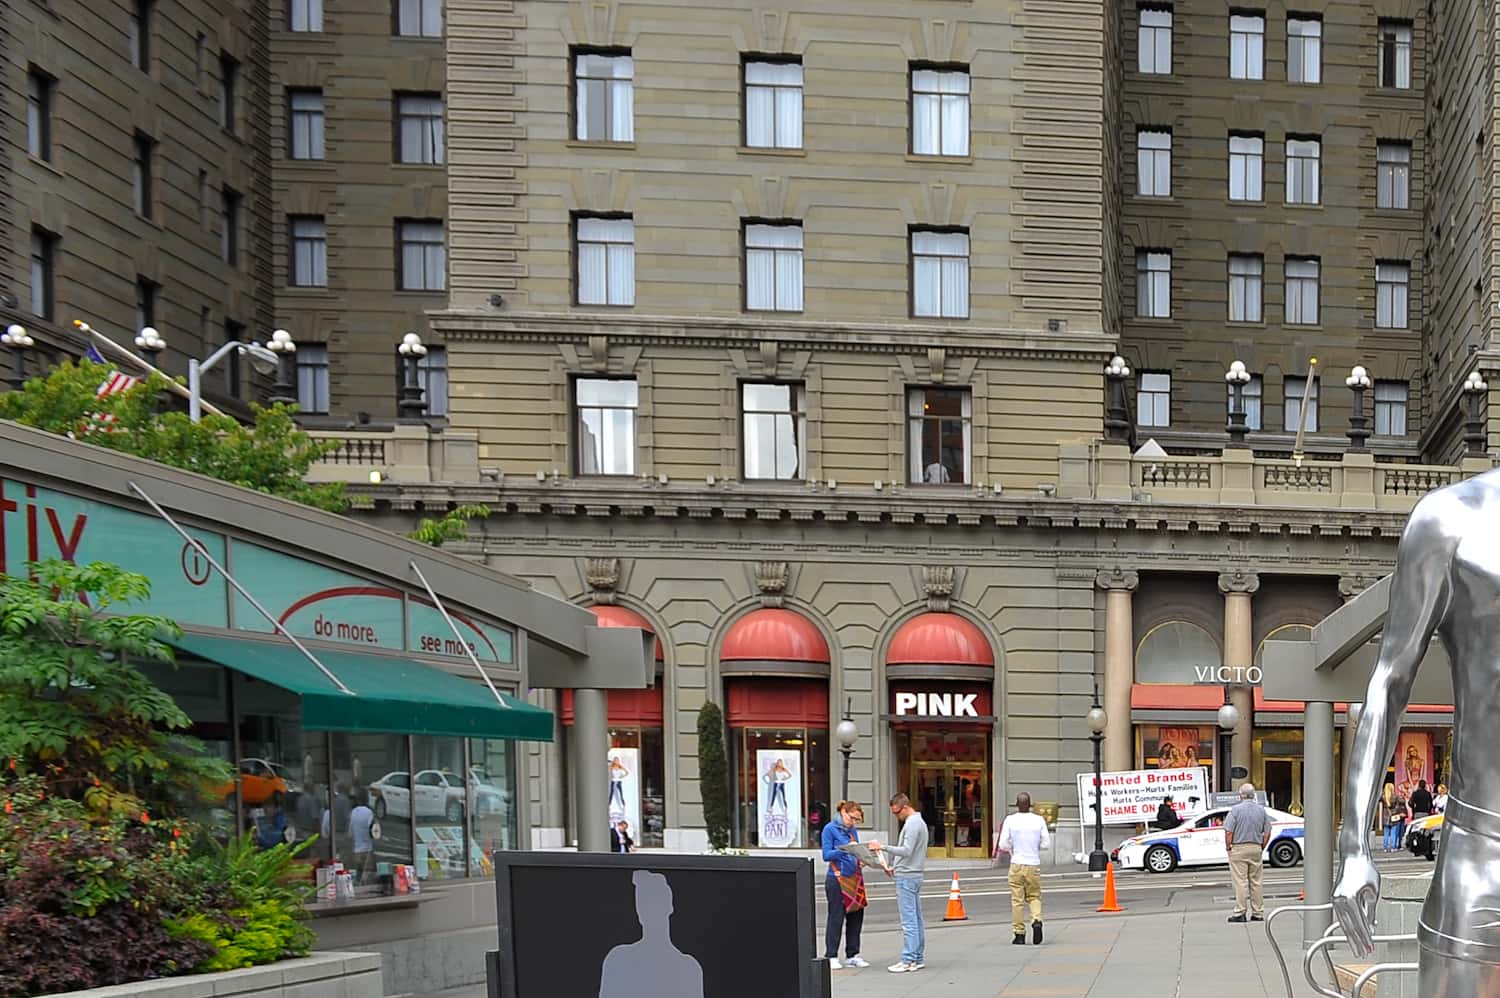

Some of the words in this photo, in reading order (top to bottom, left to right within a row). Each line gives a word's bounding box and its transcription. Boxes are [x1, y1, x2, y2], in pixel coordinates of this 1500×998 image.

[314, 614, 333, 637] do
[337, 622, 379, 644] more.
[420, 634, 442, 652] see
[896, 692, 978, 717] PINK
[1147, 771, 1193, 784] Brands
[1088, 789, 1108, 797] Hus
[1168, 783, 1198, 792] Families
[1135, 795, 1174, 803] Communy
[1104, 804, 1138, 816] SHAME
[1141, 804, 1156, 814] ON
